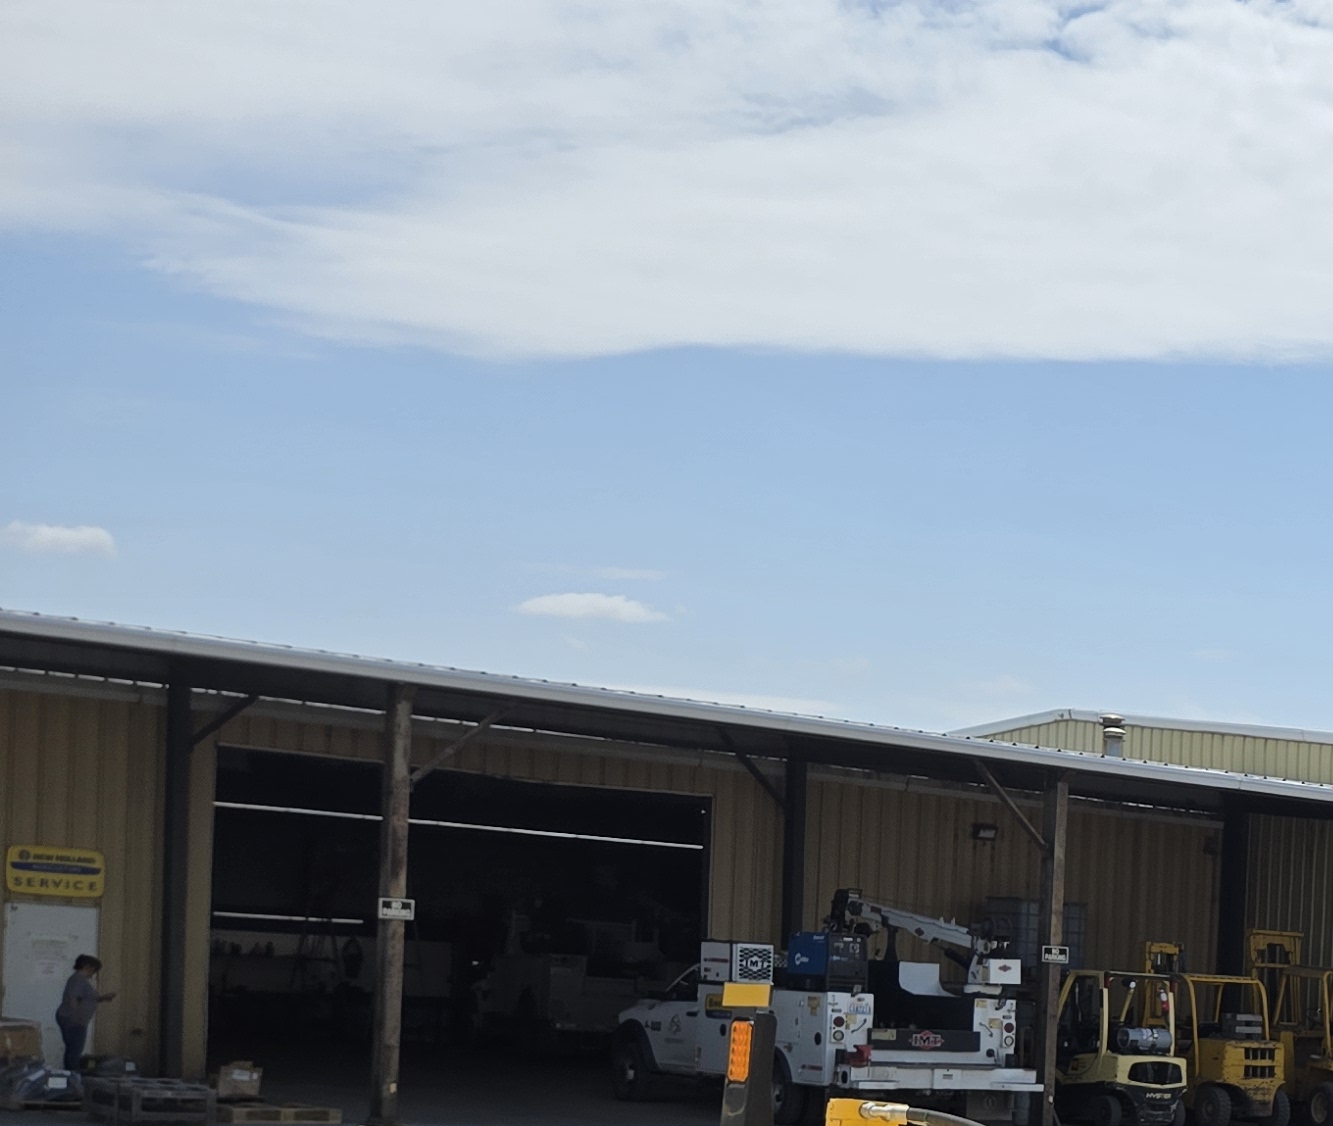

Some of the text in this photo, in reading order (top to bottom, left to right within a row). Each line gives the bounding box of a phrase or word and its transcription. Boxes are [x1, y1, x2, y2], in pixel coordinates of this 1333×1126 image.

[13, 876, 97, 892] SERVICE
[391, 901, 403, 909] NO
[382, 907, 411, 917] PARKING
[1045, 953, 1067, 961] PARKING
[744, 959, 766, 968] IMT
[911, 1033, 942, 1047] IMT
